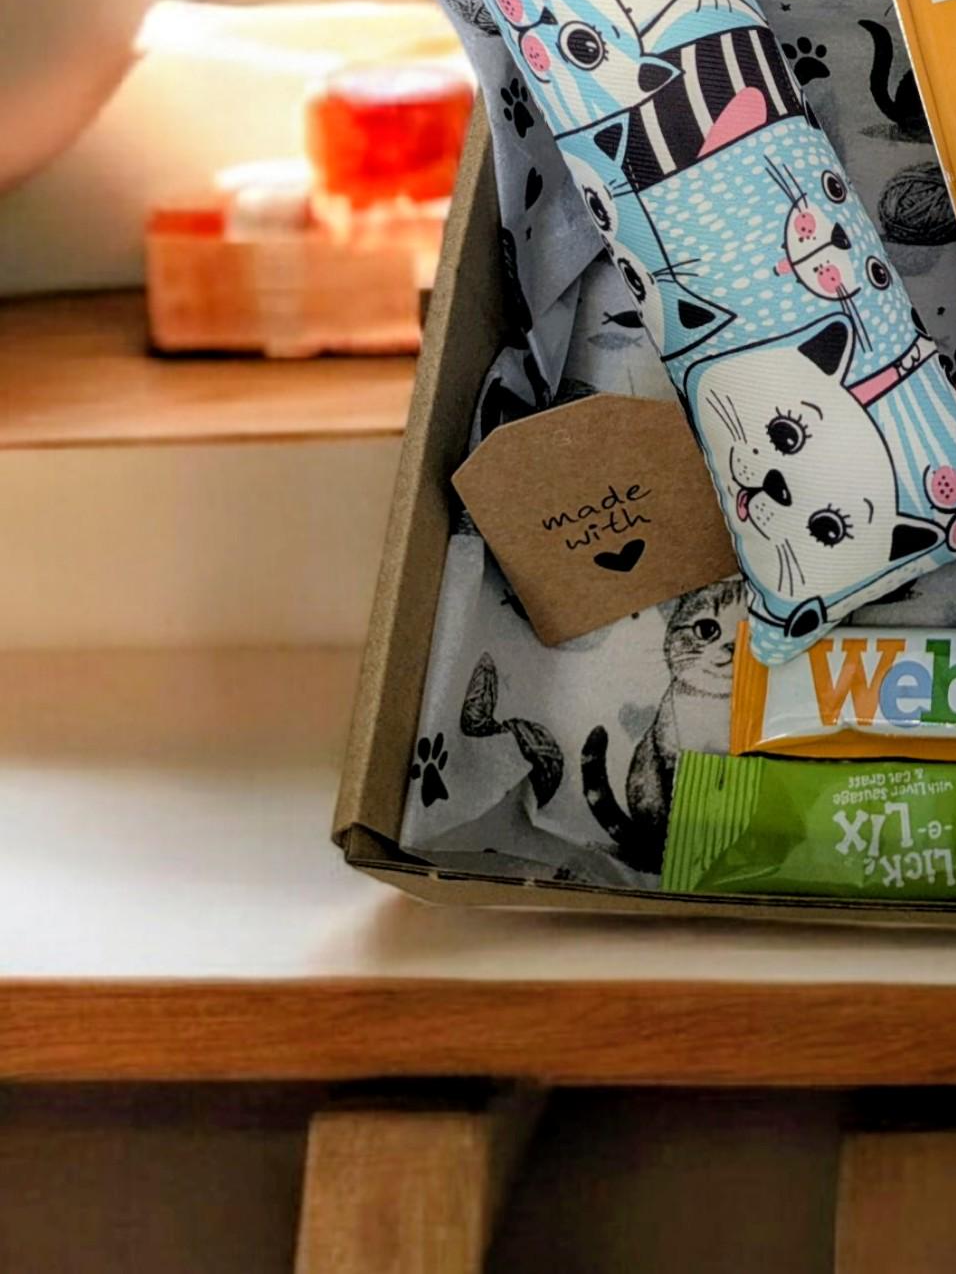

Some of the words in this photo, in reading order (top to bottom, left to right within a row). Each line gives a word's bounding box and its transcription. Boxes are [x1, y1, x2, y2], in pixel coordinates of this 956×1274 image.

[542, 483, 652, 531] made
[565, 508, 652, 549] with
[833, 788, 888, 805] Sausage
